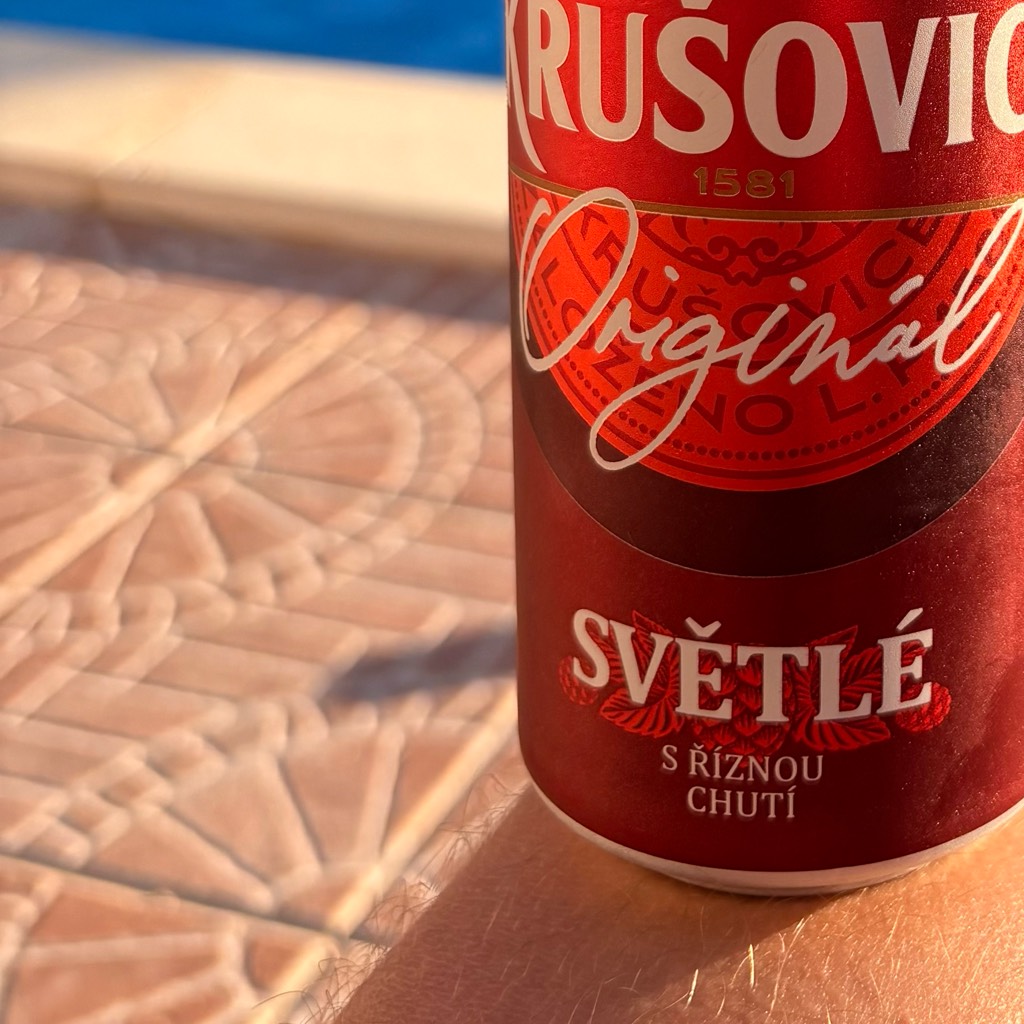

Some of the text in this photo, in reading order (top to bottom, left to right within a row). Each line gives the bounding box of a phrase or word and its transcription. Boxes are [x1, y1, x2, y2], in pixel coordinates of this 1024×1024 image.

[693, 168, 796, 200] 1581
[572, 608, 933, 724] SVĚTLÉ
[661, 742, 825, 782] S ŘÍZNOU
[687, 785, 797, 819] CHUTÍ
